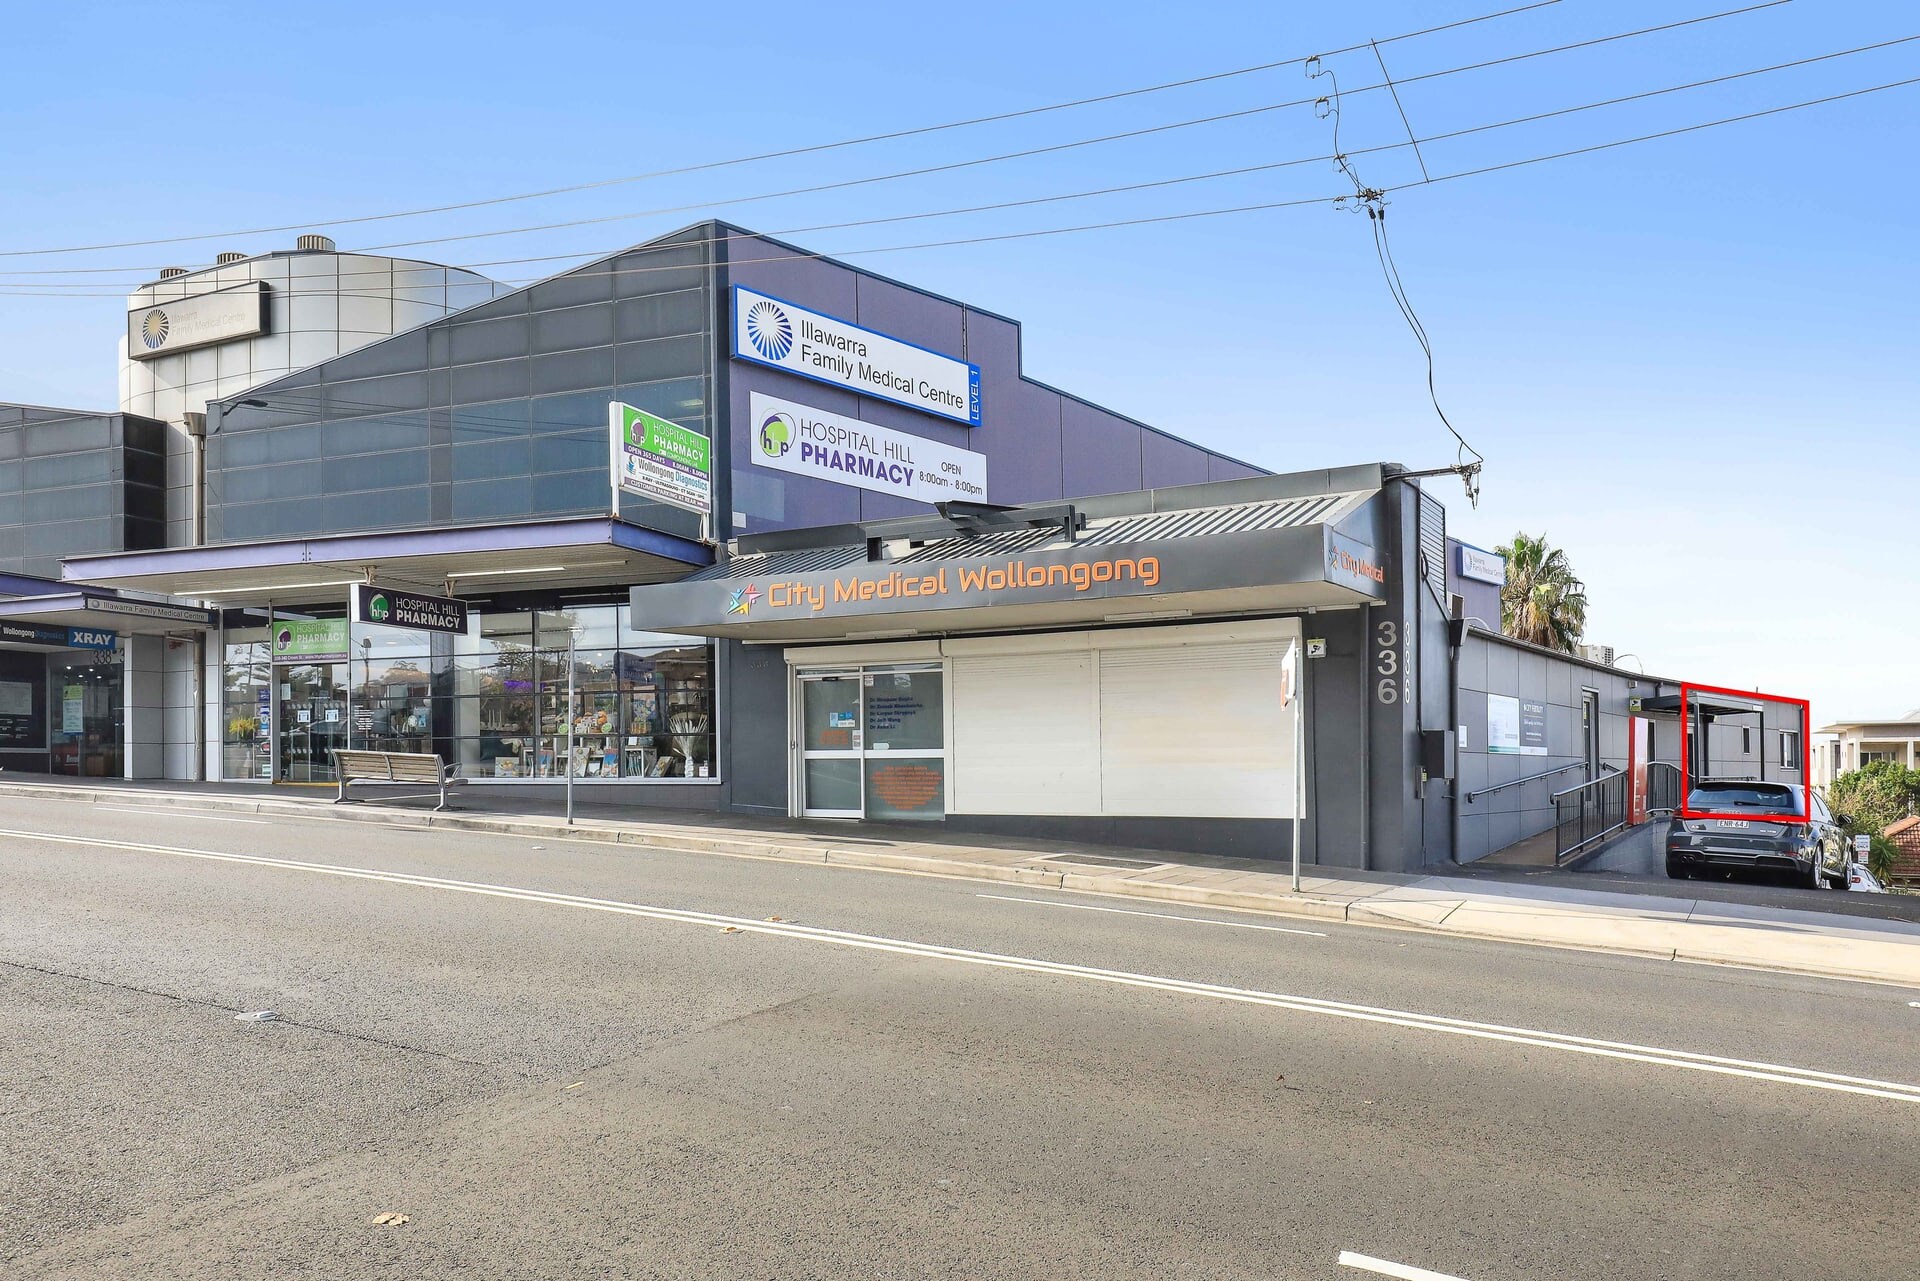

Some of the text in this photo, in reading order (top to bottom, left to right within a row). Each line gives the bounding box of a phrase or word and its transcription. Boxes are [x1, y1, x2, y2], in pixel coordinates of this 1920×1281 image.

[801, 320, 867, 358] Illawarra
[801, 344, 964, 410] Family Medical Centre
[971, 381, 979, 421] LEVEL
[653, 423, 704, 451] HOSPITAL HILL
[653, 434, 704, 462] PHARMACY
[801, 419, 914, 464] HOSPITAL HILL
[628, 446, 642, 456] OPEN
[642, 450, 652, 459] 365
[652, 453, 665, 464] DAYS
[801, 442, 914, 487] PHARMACY
[638, 458, 708, 492] Wollongong Diagnostics
[941, 462, 962, 476] OPEN
[630, 480, 658, 493] CUSTOMER
[657, 487, 679, 499] PARKING
[919, 471, 949, 488] 8:00am
[955, 480, 983, 496] 8:00pm
[1341, 551, 1384, 584] City Medical
[768, 556, 1160, 612] City Medical Wollongong
[103, 601, 205, 620] Illawarra Family Medical Centre
[395, 597, 460, 617] HOSPITAL HILL
[396, 609, 460, 629] PHARMACY
[3, 626, 35, 639] Wollongong
[73, 631, 112, 646] XRAY
[296, 624, 329, 633] HOSPITAL
[297, 632, 345, 644] PHARMACY
[1377, 621, 1398, 705] 336
